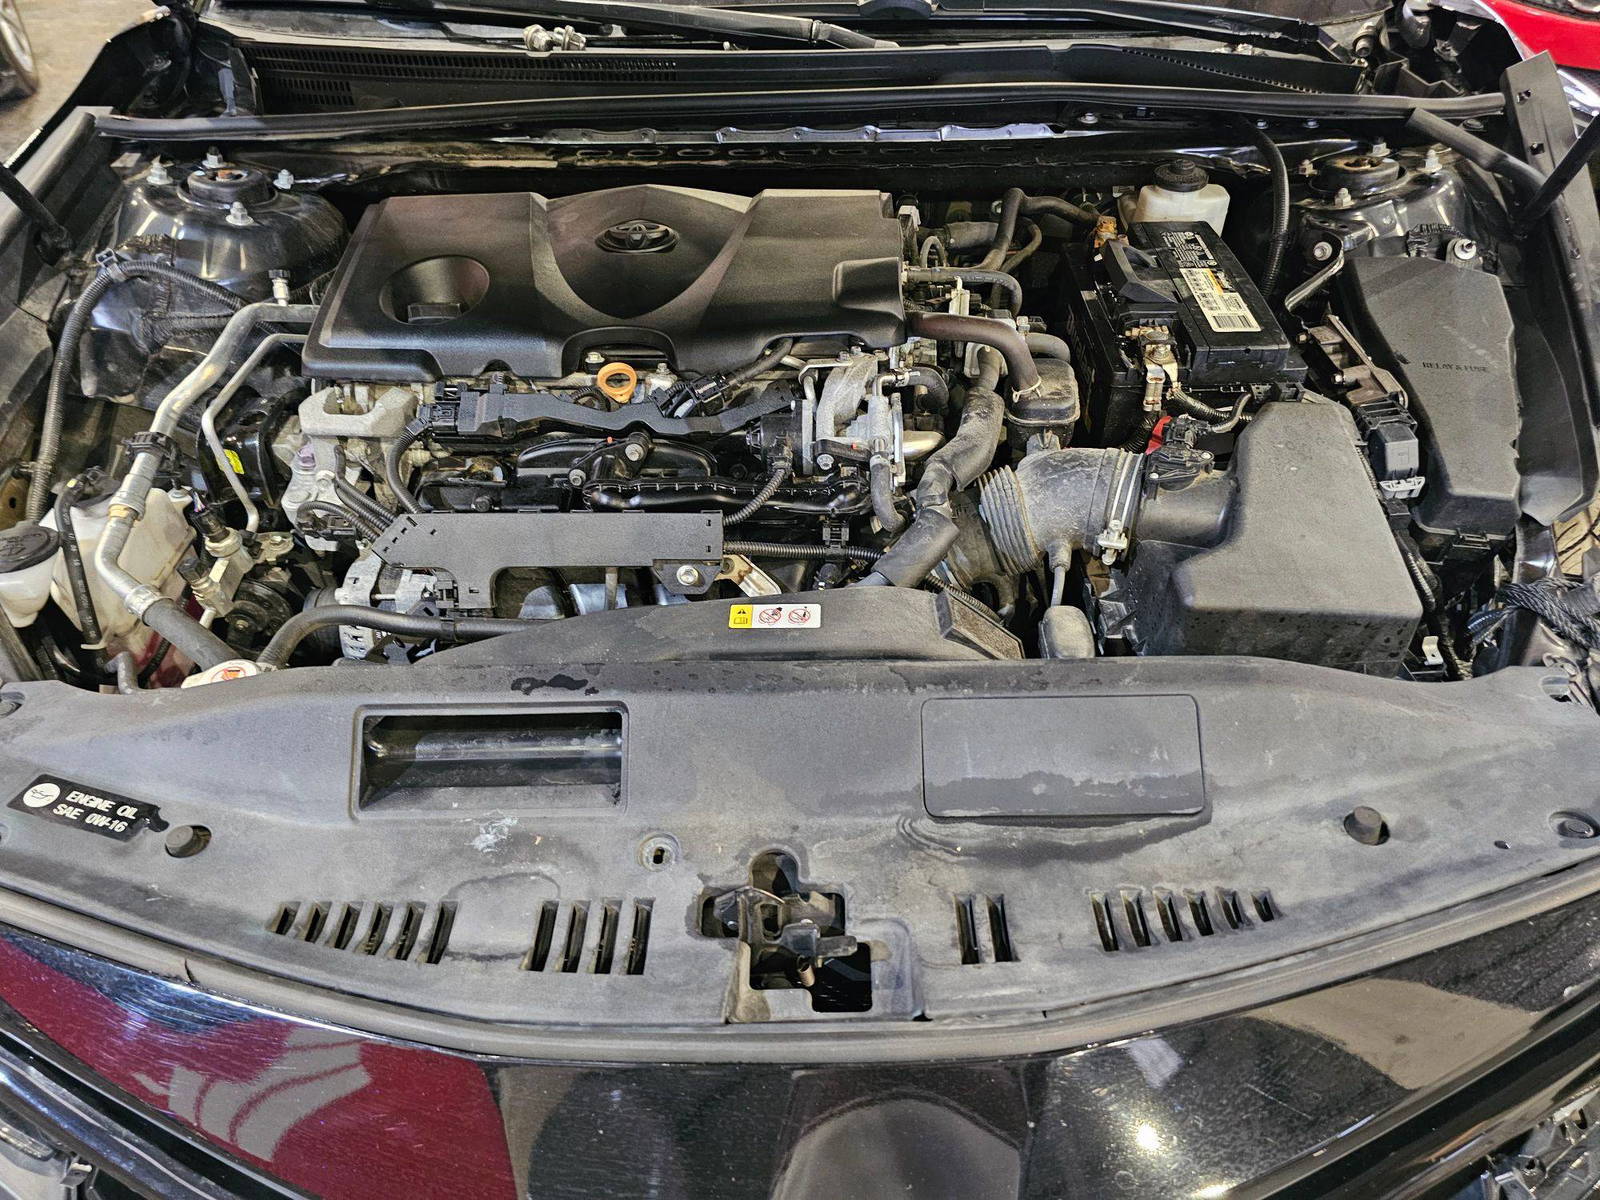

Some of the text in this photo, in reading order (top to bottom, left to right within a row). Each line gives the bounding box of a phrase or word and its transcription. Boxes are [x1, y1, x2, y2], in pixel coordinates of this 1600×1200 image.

[1422, 361, 1453, 370] RELAY
[52, 803, 129, 833] SAE 0W-16
[65, 790, 138, 820] ENGINE OIL
